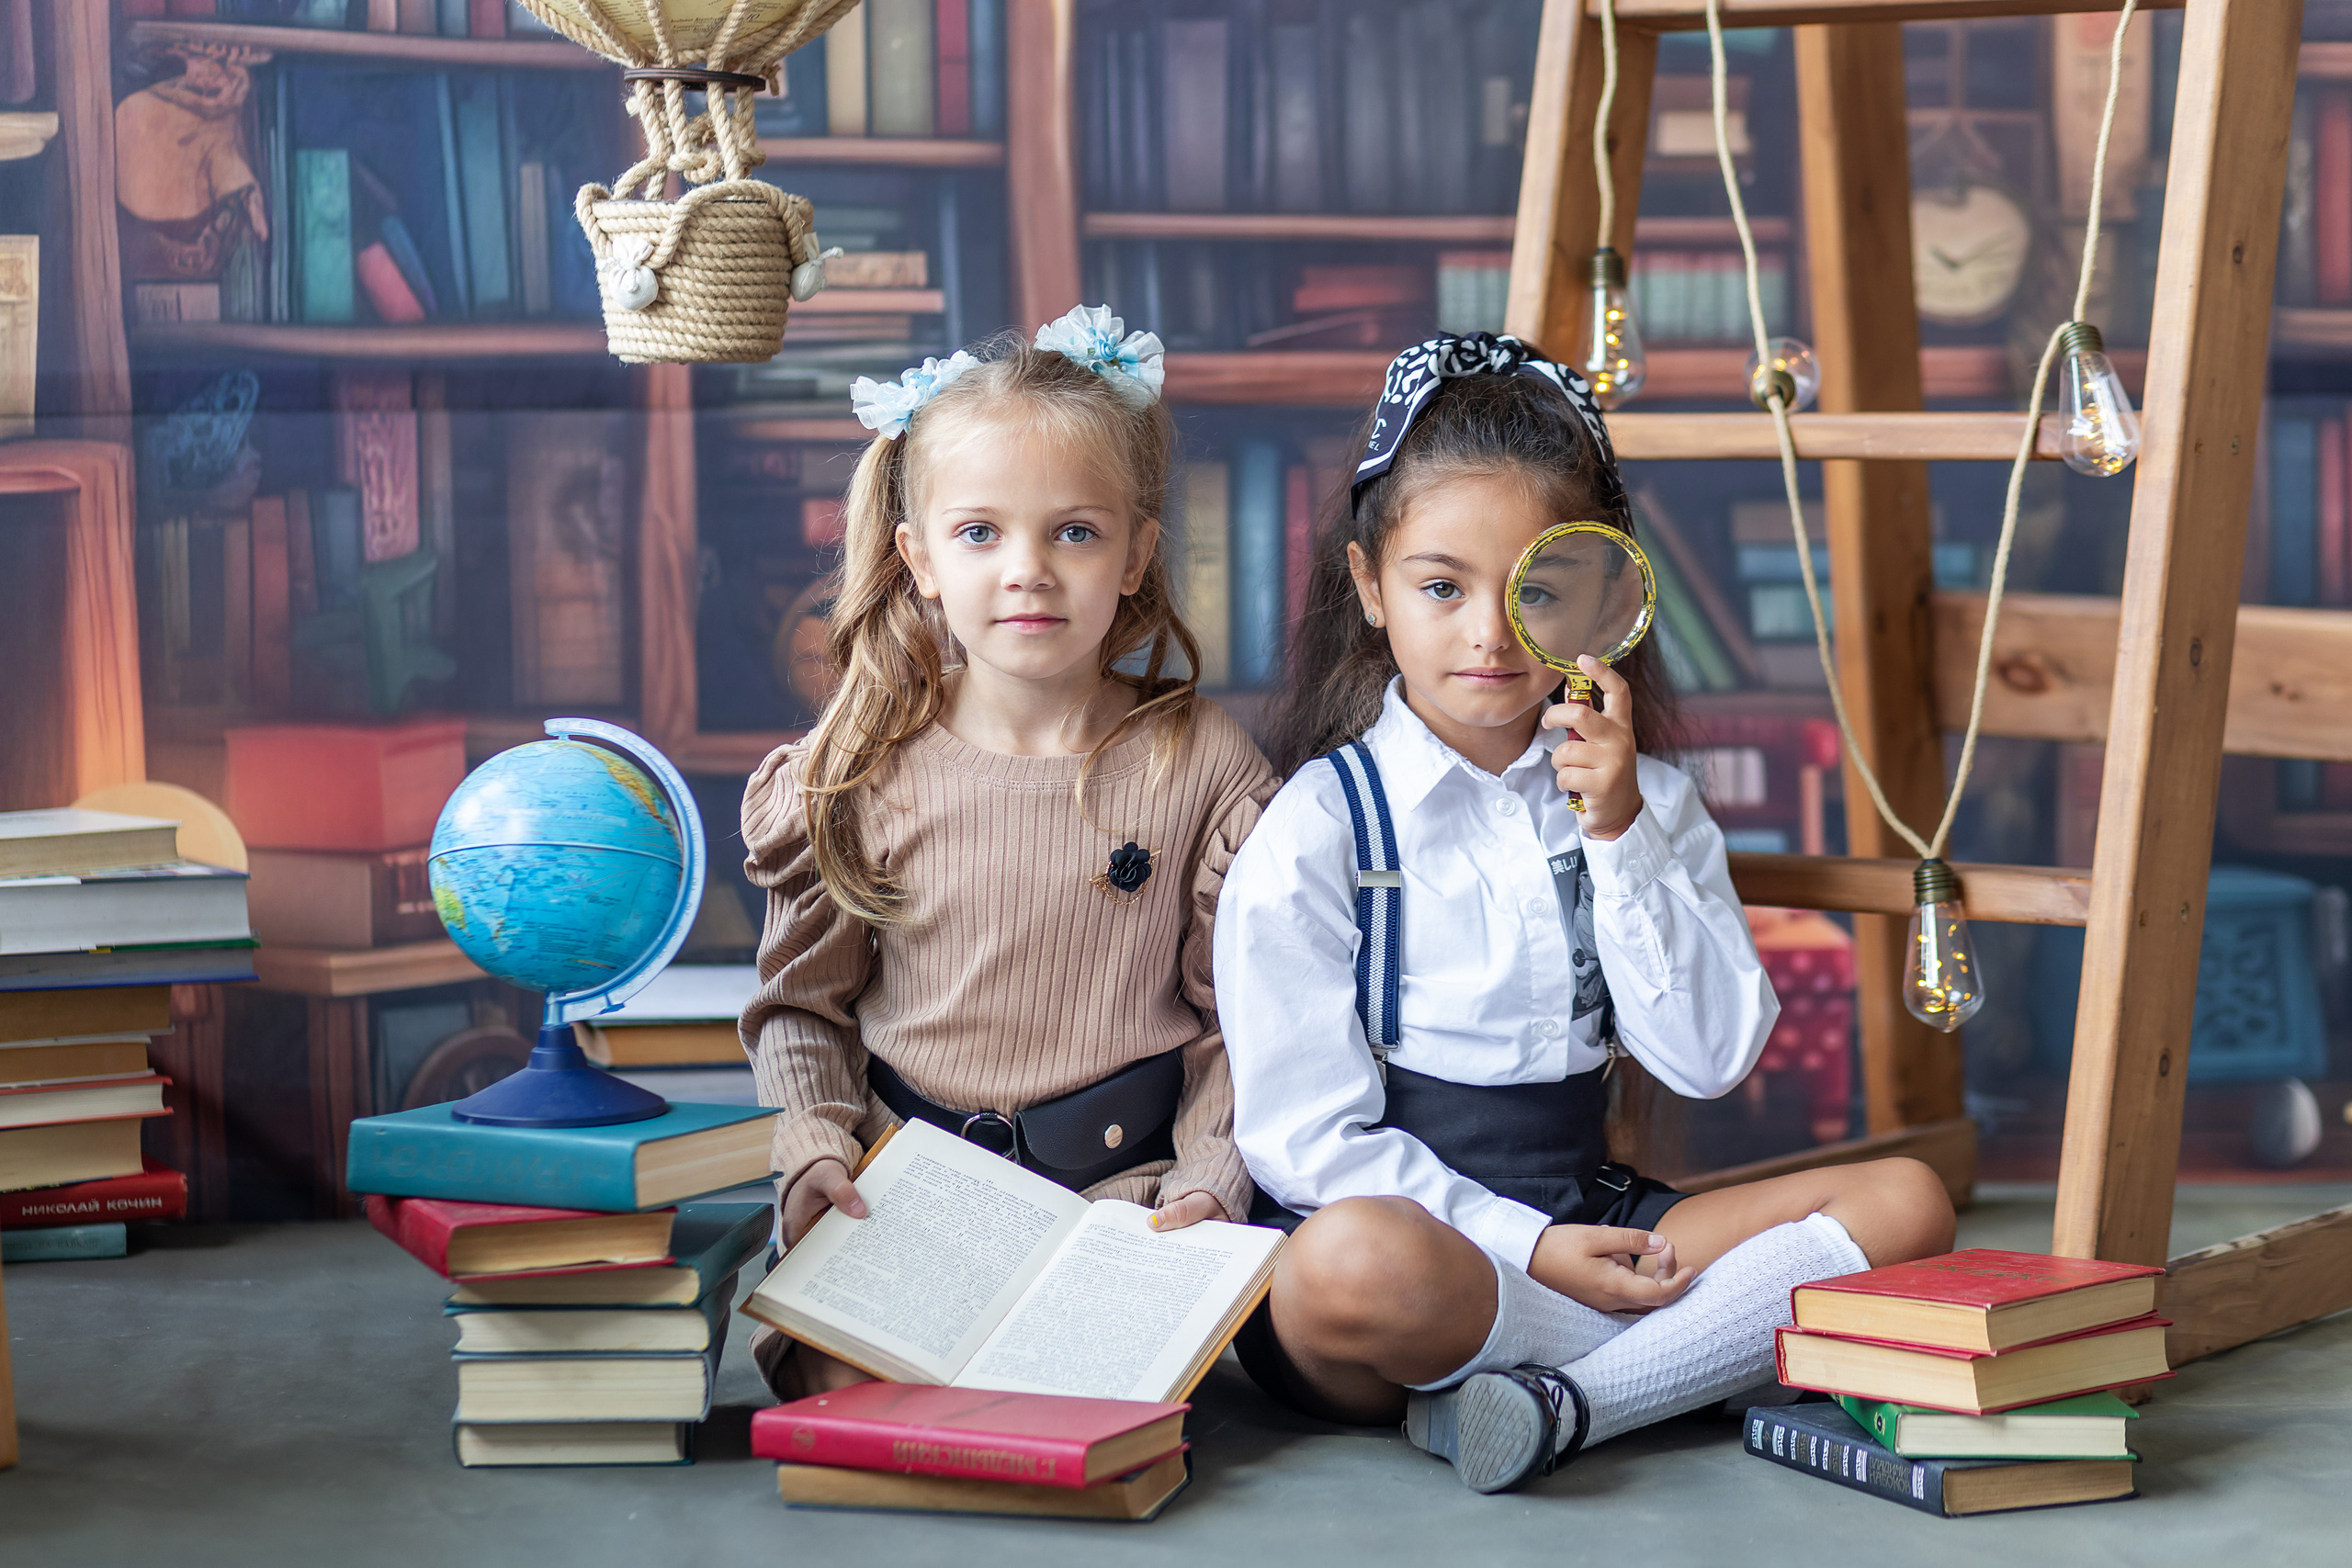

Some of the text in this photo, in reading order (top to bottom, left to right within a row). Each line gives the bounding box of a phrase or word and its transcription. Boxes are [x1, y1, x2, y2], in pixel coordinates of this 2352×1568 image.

[22, 1196, 163, 1216] НИКОЛАЙ КОЧИН
[894, 1440, 1037, 1476] МЕДЫНСКИЙ
[1869, 1456, 1911, 1481] ВЛАДИМИР
[1869, 1472, 1911, 1495] НАБОКОВ
